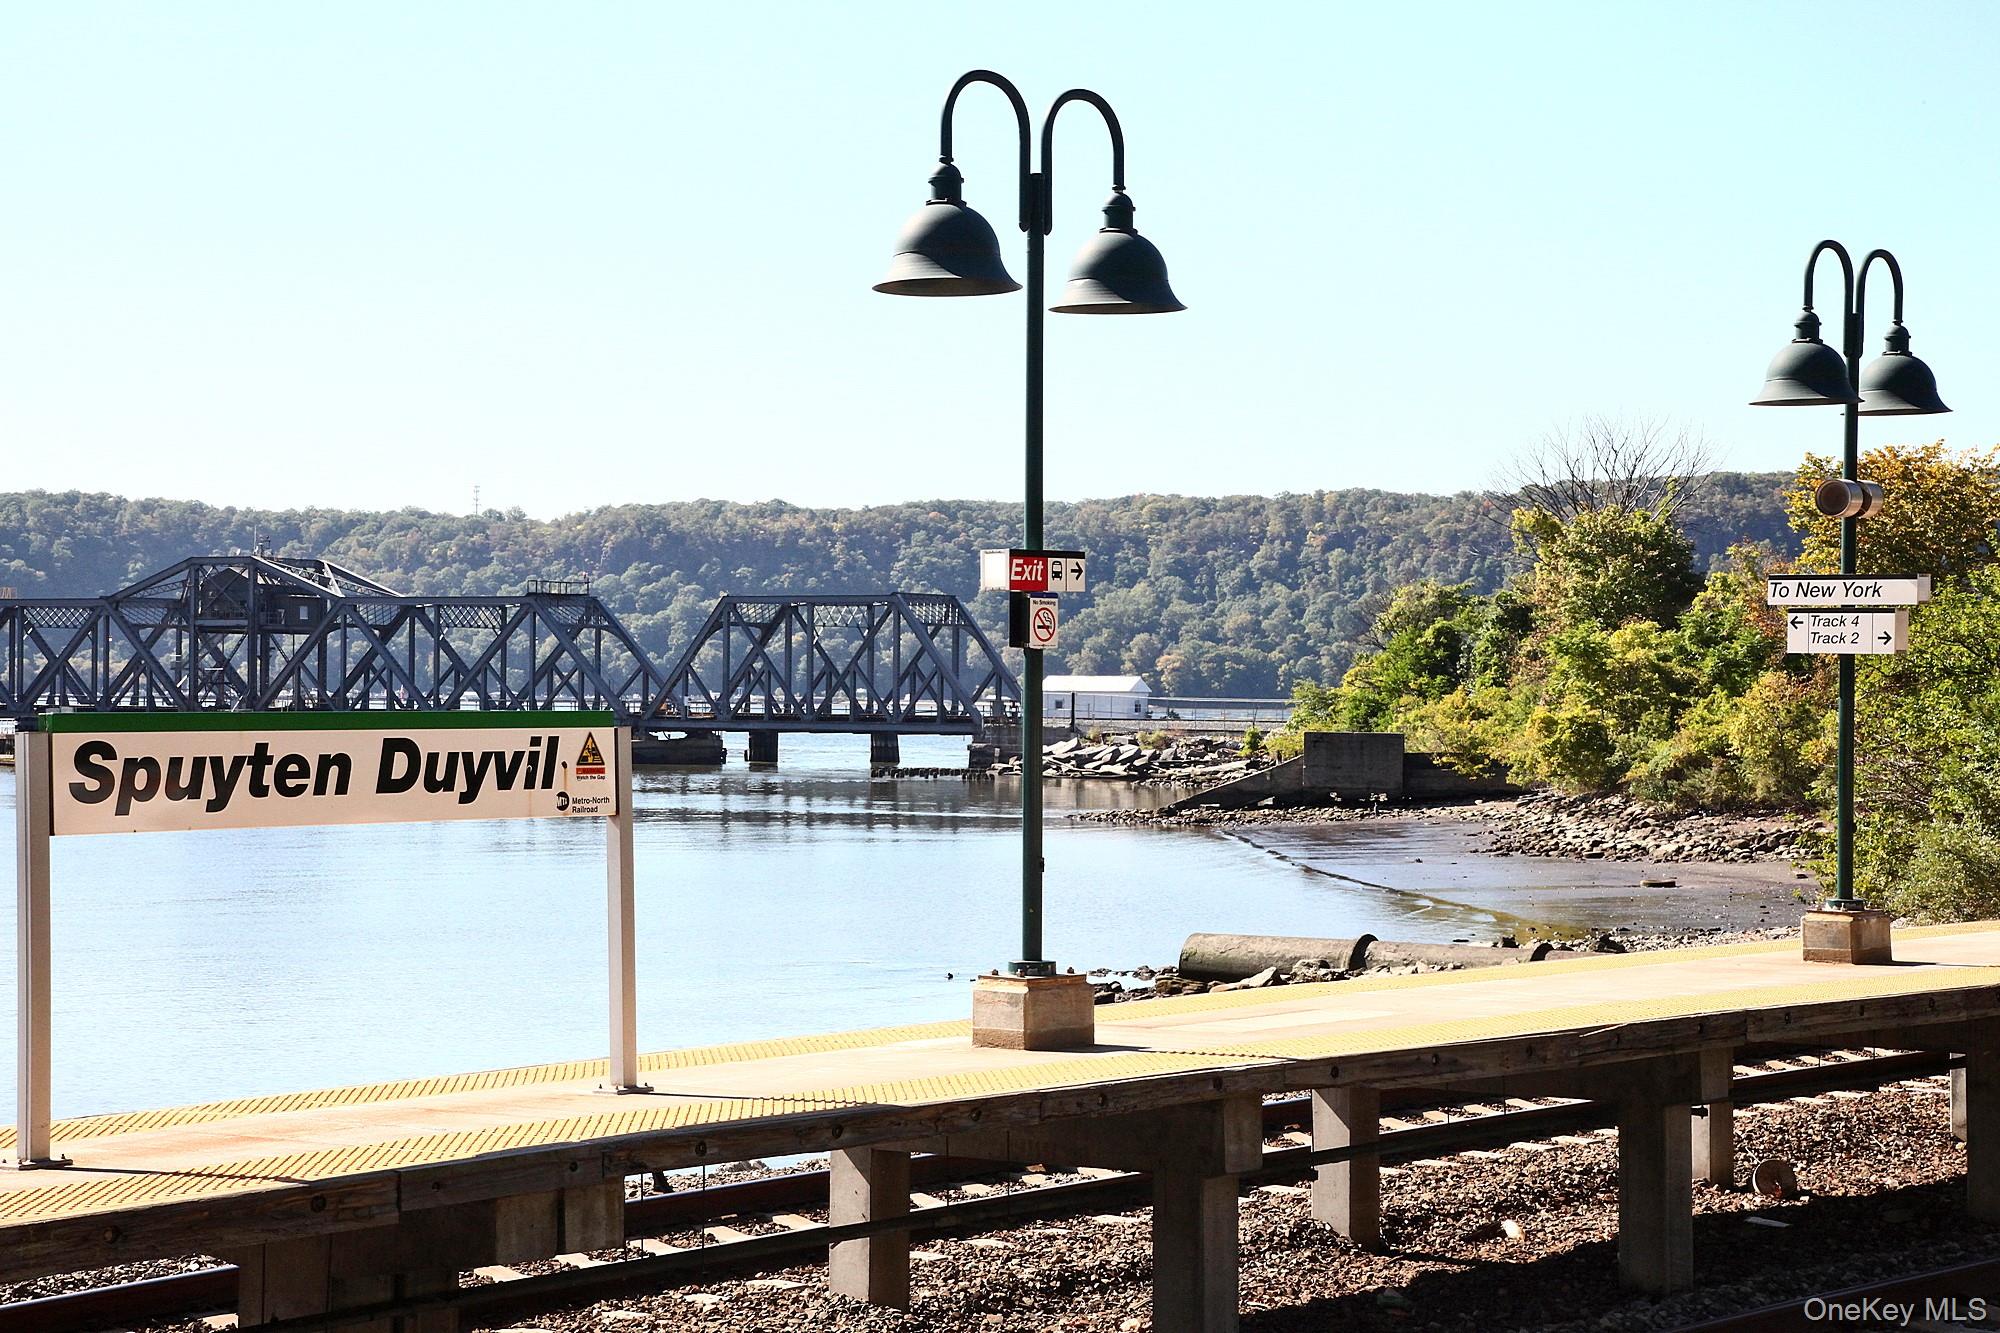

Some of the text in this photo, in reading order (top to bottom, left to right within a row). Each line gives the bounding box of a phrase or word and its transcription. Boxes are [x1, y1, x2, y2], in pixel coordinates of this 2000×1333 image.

[1010, 558, 1044, 581] Exit
[1770, 581, 1883, 598] To New York
[1811, 615, 1860, 627] Track 4
[1811, 632, 1860, 644] Track 2
[68, 735, 560, 817] Spuyten Duyvil
[572, 796, 610, 805] Metro-North
